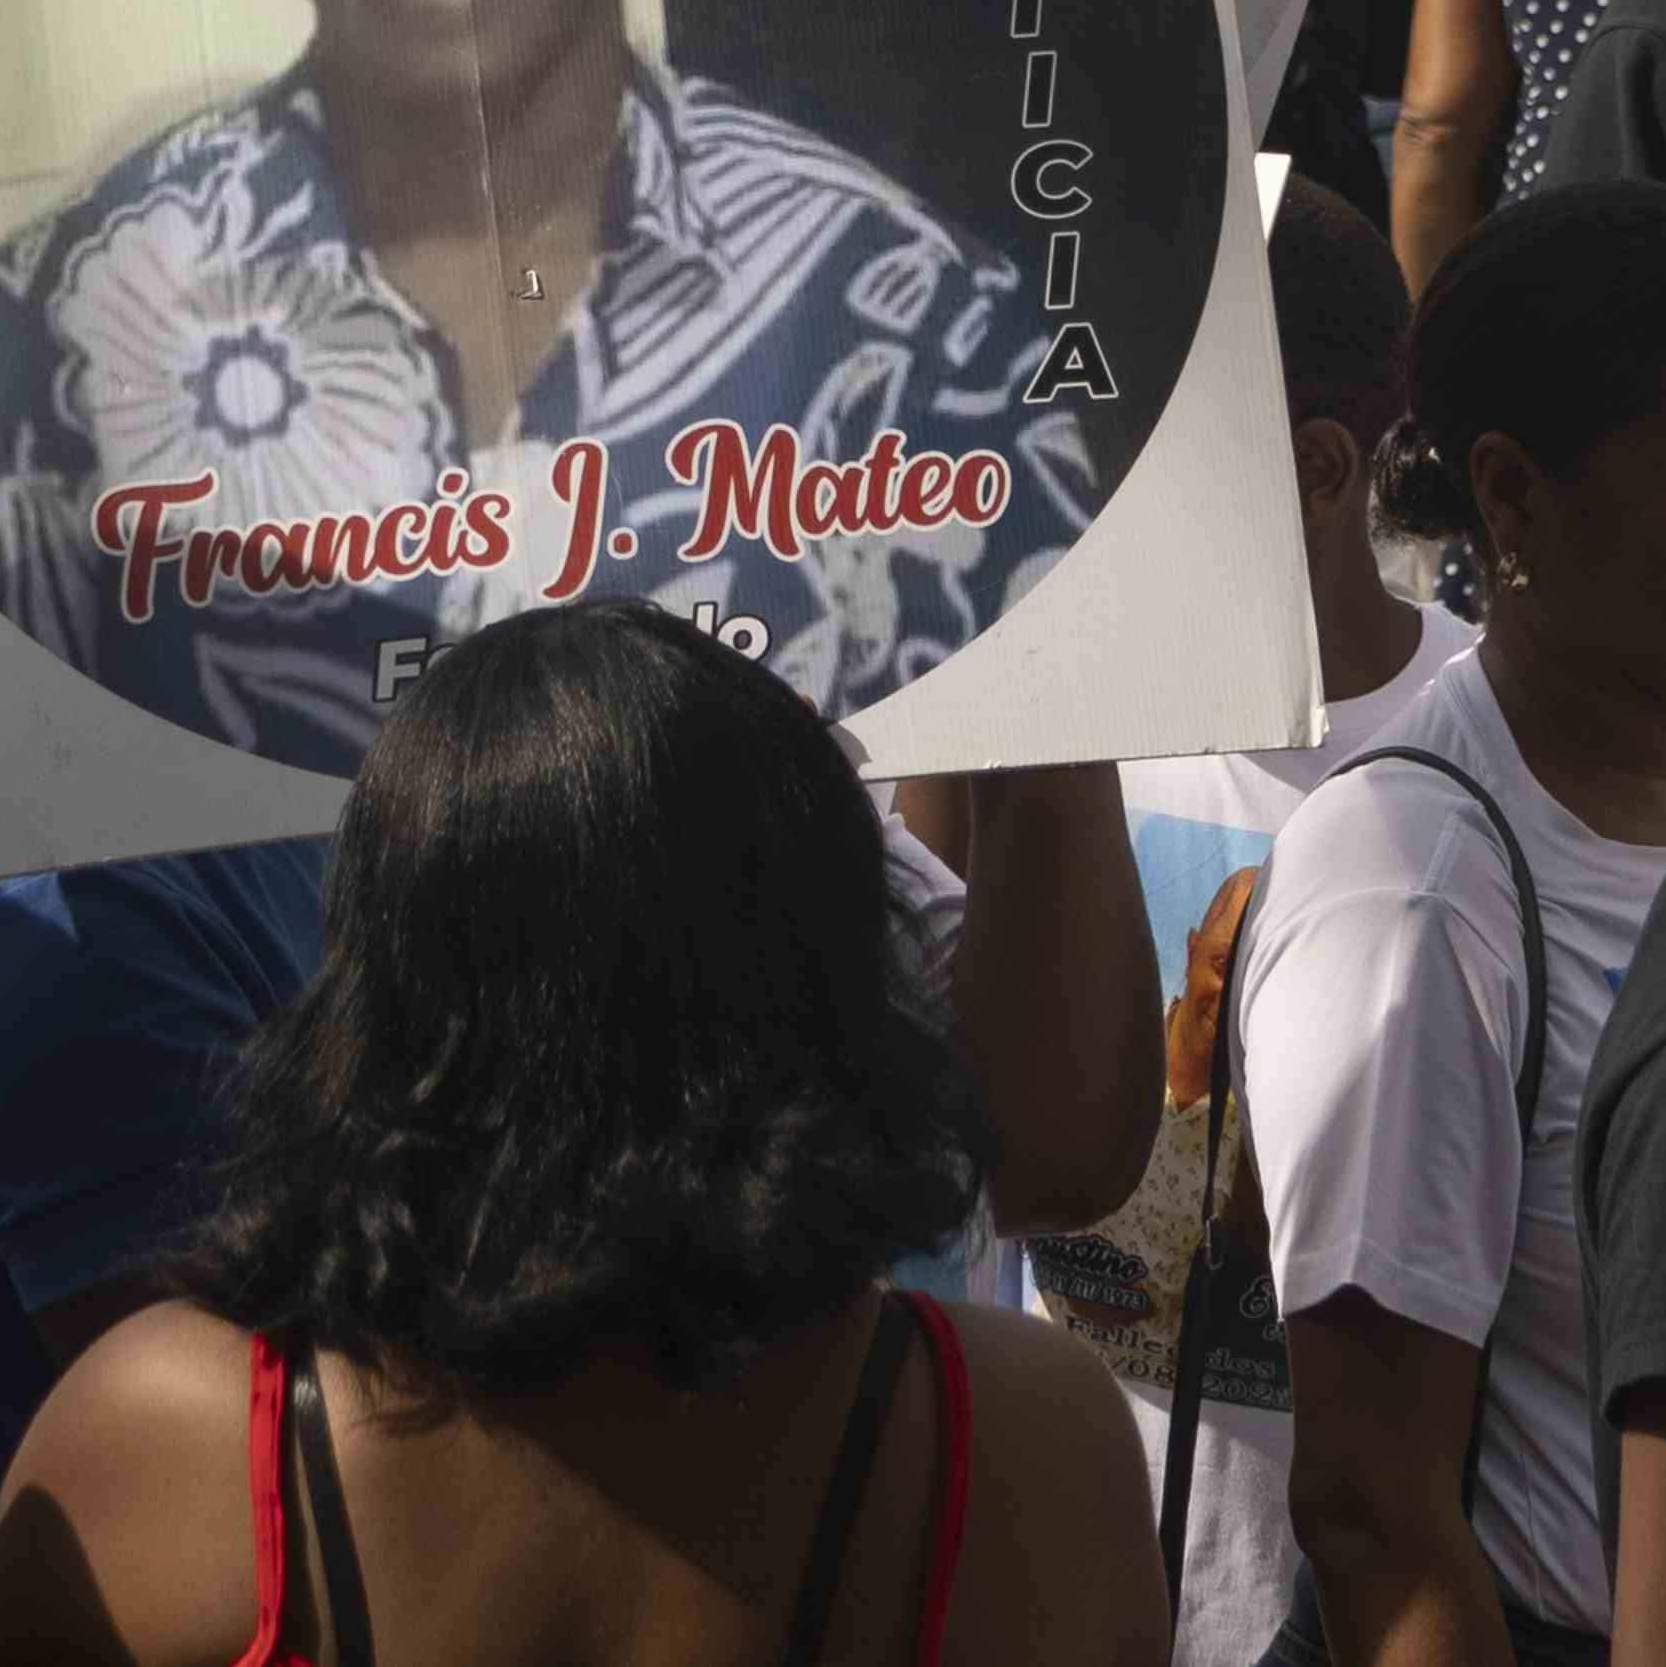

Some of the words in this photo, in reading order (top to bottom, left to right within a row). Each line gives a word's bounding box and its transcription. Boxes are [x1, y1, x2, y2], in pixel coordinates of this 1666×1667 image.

[91, 466, 510, 624] Francis
[542, 439, 640, 600] J.
[670, 415, 1013, 564] Mateo
